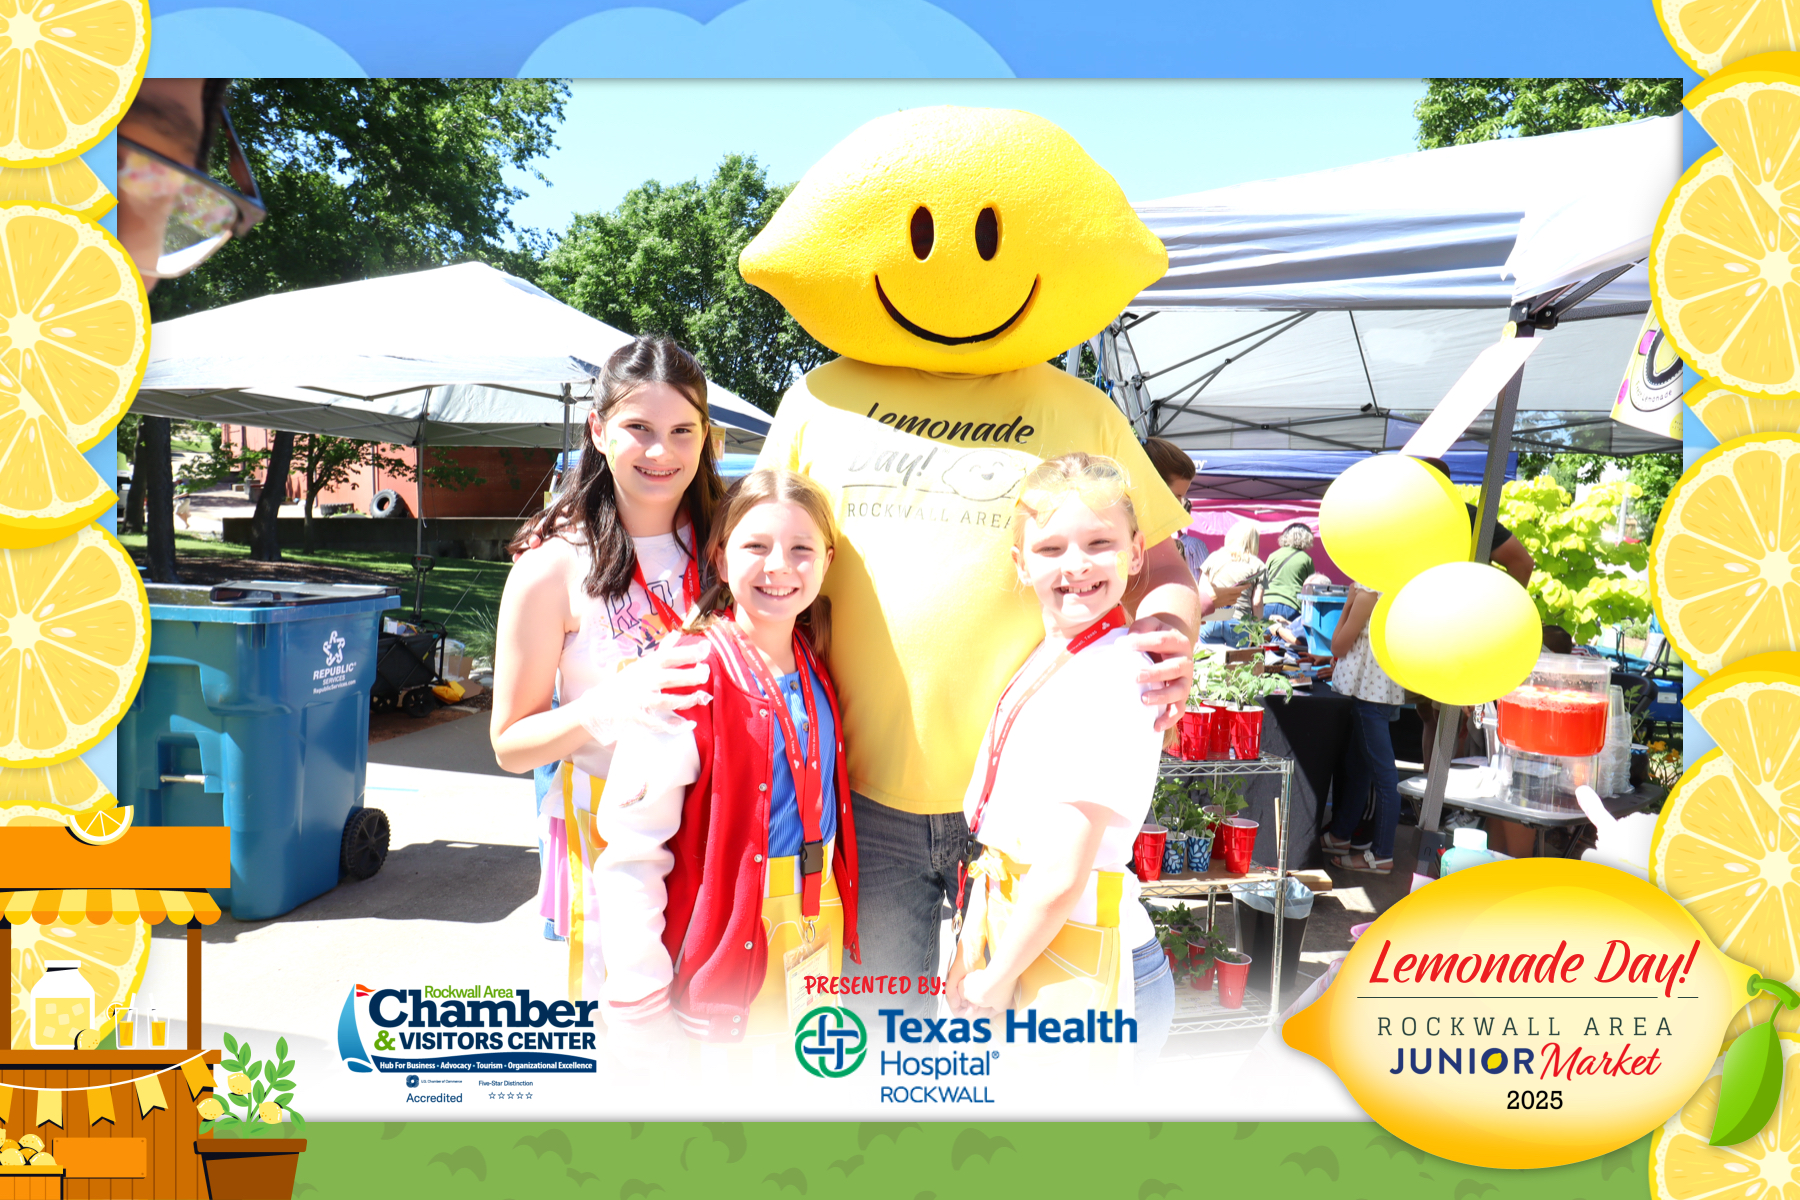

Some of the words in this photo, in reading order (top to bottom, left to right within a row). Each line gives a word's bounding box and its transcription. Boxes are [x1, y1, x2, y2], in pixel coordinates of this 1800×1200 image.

[847, 502, 950, 523] ROCKWALL
[312, 680, 356, 694] RepublicServices.com
[322, 674, 346, 686] SERVICES
